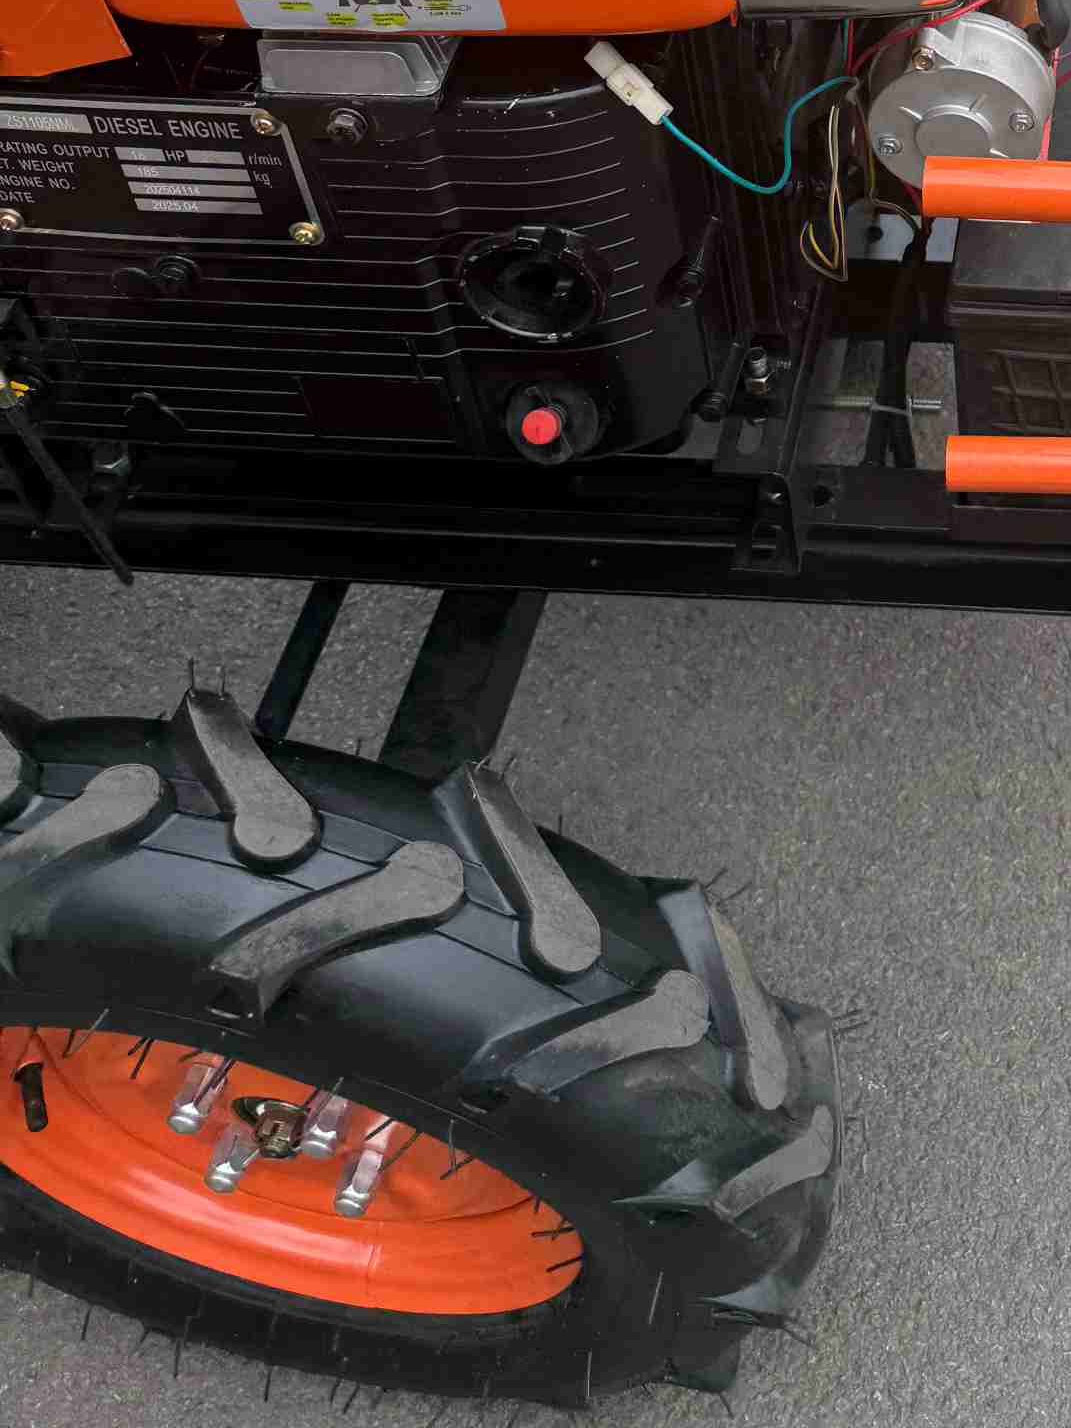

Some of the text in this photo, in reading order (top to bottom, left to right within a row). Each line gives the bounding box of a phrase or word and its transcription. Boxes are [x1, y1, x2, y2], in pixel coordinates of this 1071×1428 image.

[94, 116, 163, 136] DIESEL
[168, 119, 243, 139] ENGINE
[53, 144, 111, 159] OUTPUT
[165, 149, 185, 162] HP
[248, 154, 282, 167] r/min
[0, 175, 45, 188] NGINE
[48, 177, 77, 190] NO.
[17, 159, 75, 173] WEIGHT
[253, 171, 270, 186] kg
